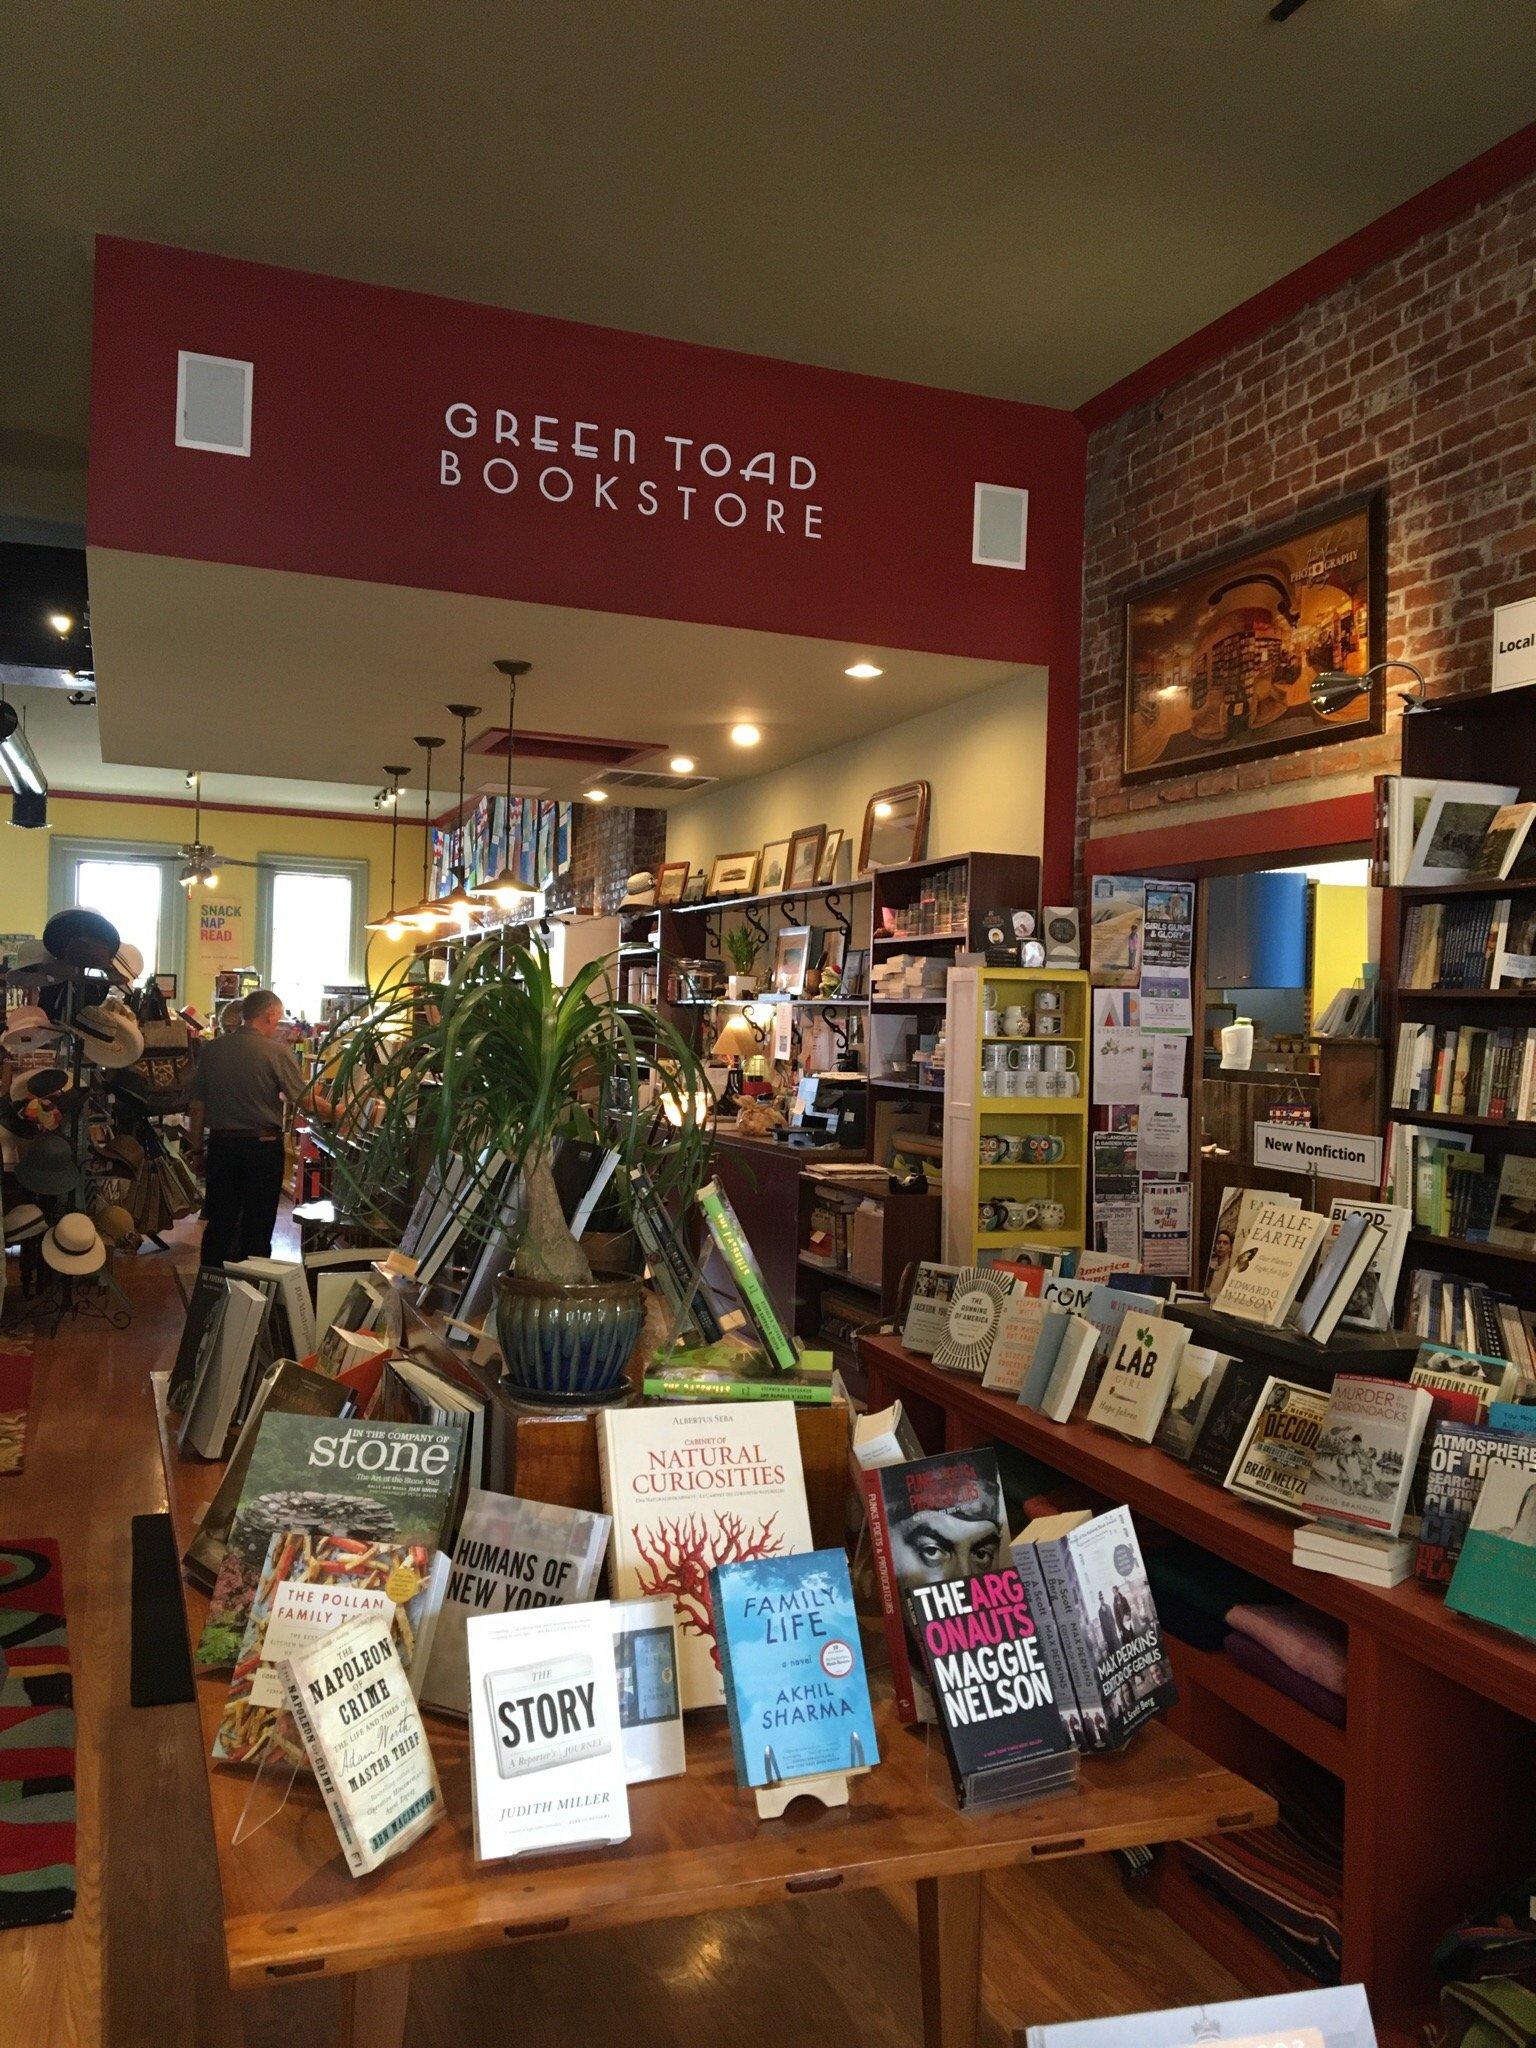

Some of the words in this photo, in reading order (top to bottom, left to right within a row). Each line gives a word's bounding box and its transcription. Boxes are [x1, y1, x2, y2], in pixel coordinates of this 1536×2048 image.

[445, 402, 636, 465] GREEN
[664, 435, 817, 490] TOAD
[440, 449, 823, 539] BOOKSTORE
[1499, 633, 1535, 654] Local
[201, 904, 242, 917] SNACK
[201, 916, 225, 929] NAP
[200, 929, 232, 941] READ
[1265, 1137, 1293, 1153] New
[1296, 1141, 1365, 1163] Nonfiction
[1259, 1210, 1313, 1231] HALF-
[1251, 1227, 1307, 1249] EARTH
[971, 1297, 983, 1305] THE
[1223, 1290, 1275, 1312] WILSON
[1228, 1278, 1270, 1296] EDWARD
[1114, 1343, 1158, 1379] LAB
[1331, 1400, 1408, 1423] ADIRONDACKS
[1334, 1386, 1395, 1407] MURDER
[352, 1429, 363, 1437] IN
[365, 1430, 385, 1439] THE
[387, 1431, 434, 1442] COMPANY
[435, 1435, 450, 1443] OF
[684, 1438, 715, 1446] CABINET
[1263, 1412, 1322, 1452] DECOD
[308, 1428, 450, 1476] stone
[648, 1444, 767, 1470] NATURAL
[1430, 1448, 1462, 1473] OF
[1433, 1433, 1536, 1463] ATMOSPHERE
[632, 1465, 786, 1495] CURIOSITIES
[1243, 1461, 1271, 1480] BRAD
[1271, 1470, 1308, 1495] MELTZ
[456, 1538, 538, 1582] HUMANS
[542, 1558, 572, 1589] OF
[288, 1589, 315, 1603] THE
[321, 1592, 384, 1610] POLLAN
[447, 1571, 498, 1608] NEW
[743, 1586, 839, 1618] FAMILY
[913, 1580, 973, 1622] THE
[970, 1570, 1024, 1611] ARG
[1034, 1590, 1047, 1615] Scott
[1060, 1588, 1073, 1613] Scott
[278, 1606, 333, 1623] FAMILY
[766, 1611, 827, 1645] LIFE
[925, 1602, 1036, 1657] ONAUTS
[336, 1645, 354, 1660] THE
[790, 1656, 812, 1667] novel
[934, 1636, 1045, 1693] MAGGIE
[1070, 1622, 1082, 1645] MAX
[1077, 1646, 1093, 1687] PERKINS
[1097, 1654, 1119, 1681] MAX
[1115, 1630, 1158, 1666] PERKINS
[308, 1637, 393, 1705] NAPOLEON
[531, 1669, 553, 1682] THE
[1051, 1649, 1067, 1690] PERKINS
[1102, 1670, 1124, 1696] EDITOR
[1122, 1663, 1133, 1680] OF
[1132, 1648, 1162, 1673] GENIUS
[351, 1680, 363, 1692] OF
[775, 1682, 835, 1705] AKHIL
[944, 1670, 1054, 1728] NELSON
[338, 1678, 391, 1726] CRIME
[498, 1681, 595, 1749] STORY
[762, 1698, 855, 1730] SHARMA
[287, 1684, 316, 1744] NAPOLEON
[314, 1757, 335, 1795] CRIME
[333, 1742, 347, 1753] THE
[349, 1730, 364, 1744] LIFE
[365, 1718, 380, 1732] AND
[380, 1704, 400, 1723] TIMES
[348, 1751, 391, 1793] MASTER
[391, 1731, 420, 1762] THIEF
[508, 1759, 516, 1769] A
[562, 1738, 605, 1758] JOURNEY
[372, 1835, 390, 1851] BEN
[392, 1789, 436, 1834] MACINTYRE
[498, 1800, 553, 1822] JUDITH
[556, 1791, 611, 1811] MILLER
